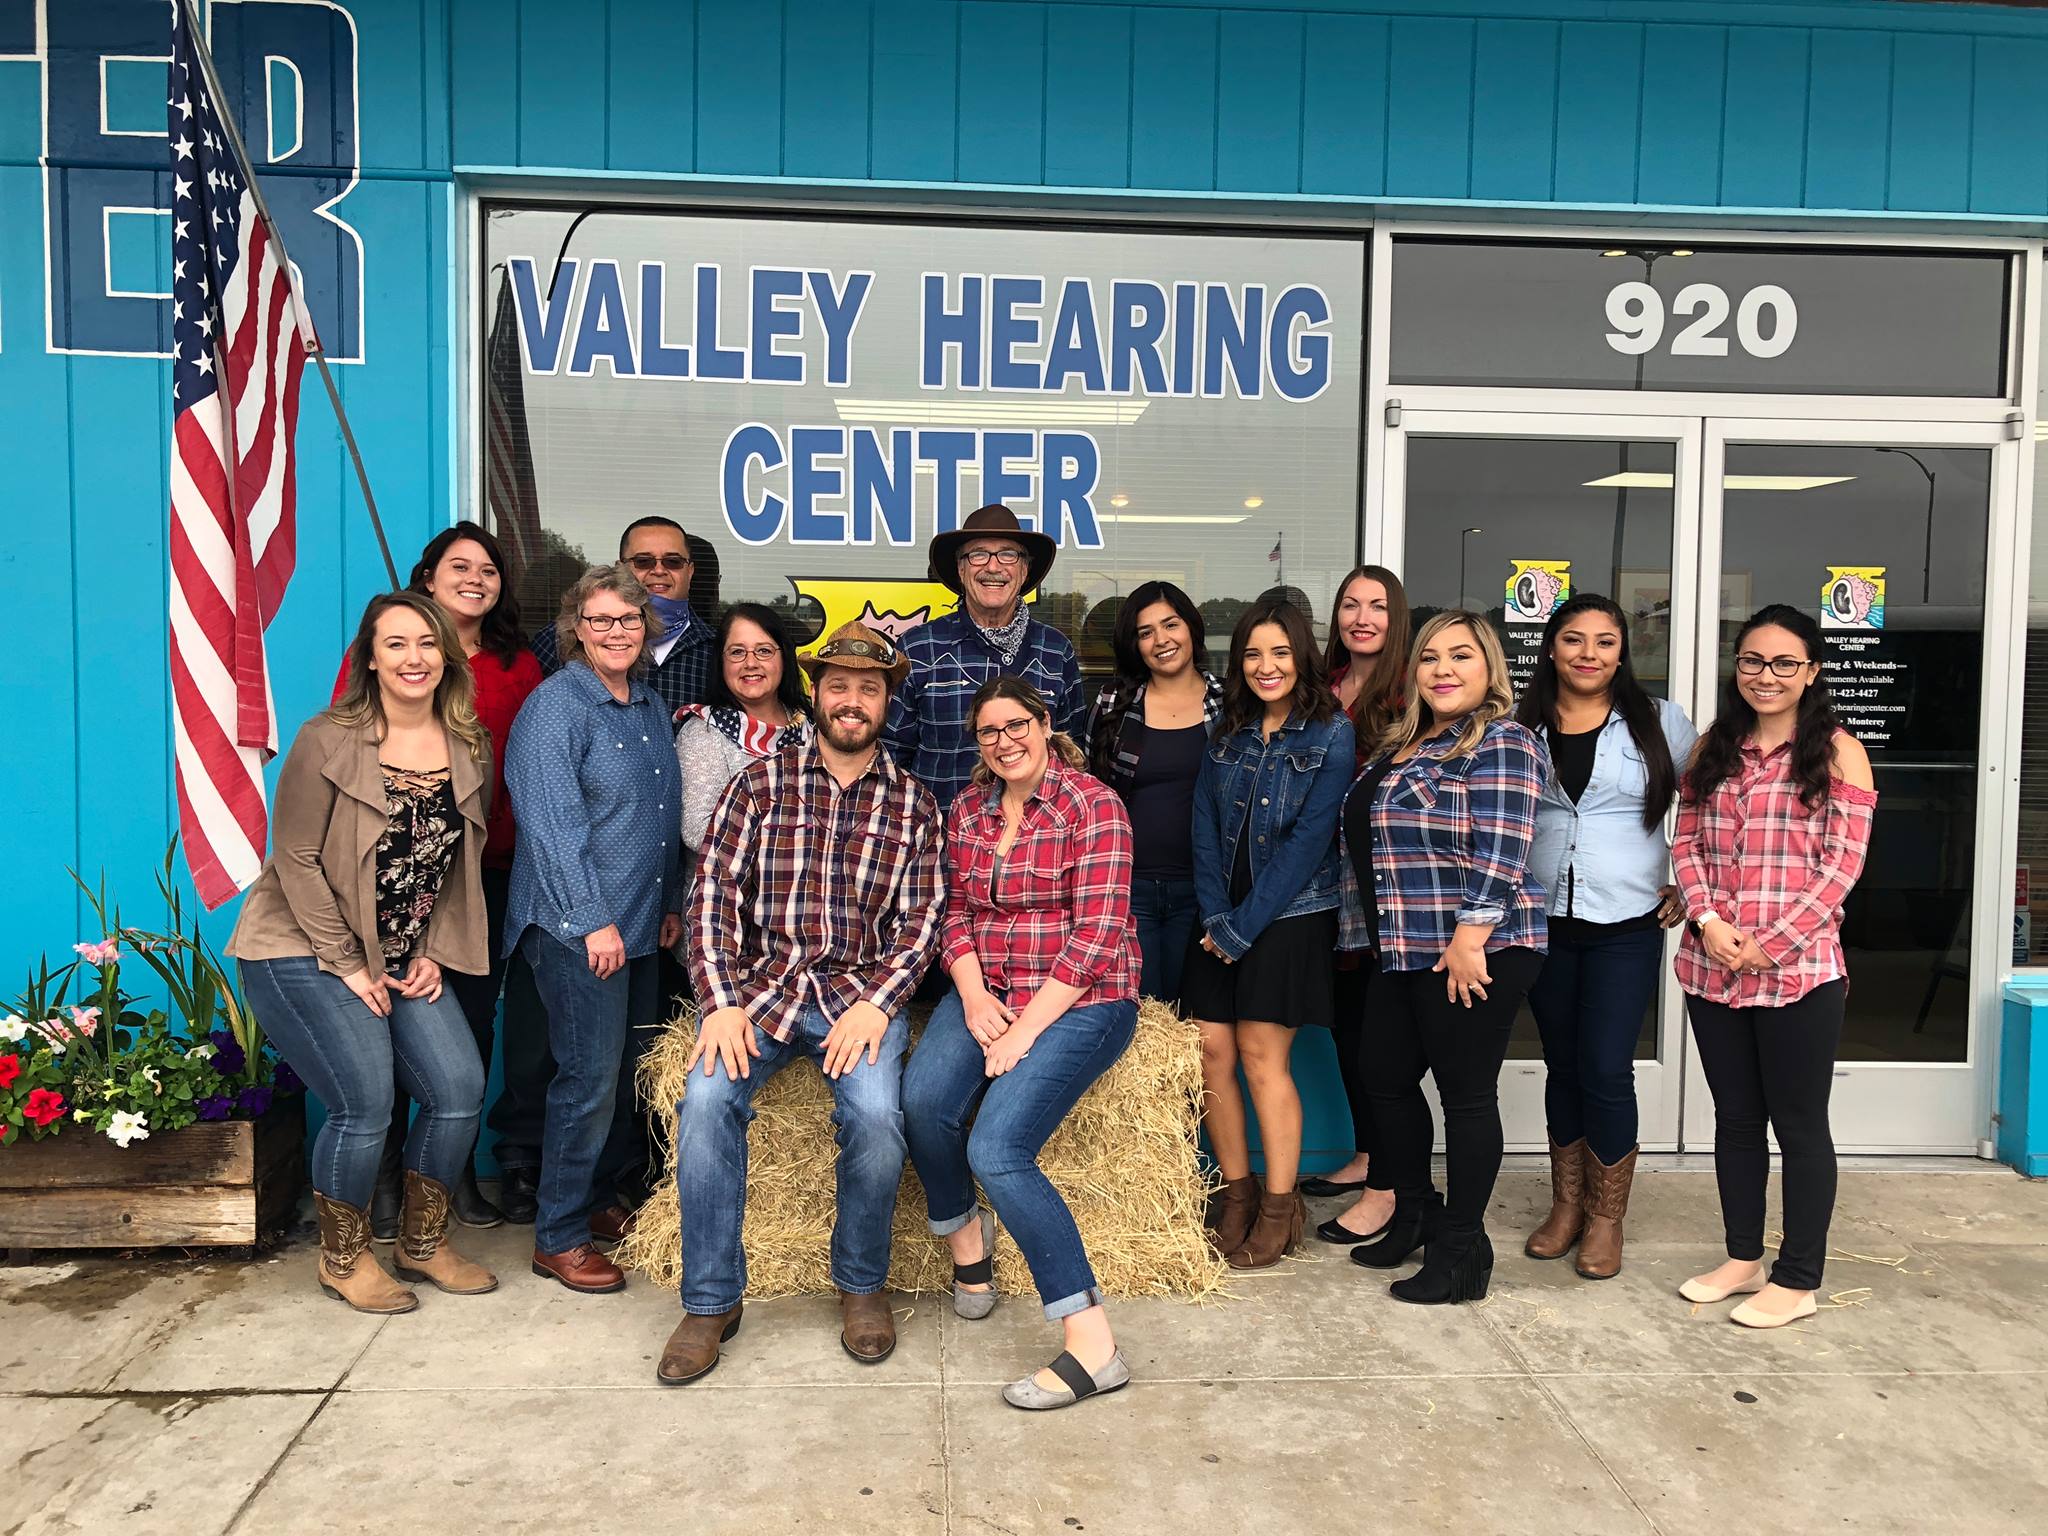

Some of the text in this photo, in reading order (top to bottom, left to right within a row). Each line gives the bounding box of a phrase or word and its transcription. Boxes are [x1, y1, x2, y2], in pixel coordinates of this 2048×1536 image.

[0, 0, 365, 364] ER
[1604, 281, 1798, 359] 920
[506, 255, 1333, 403] VALLEY HEARING
[720, 421, 1104, 550] CENTER
[1824, 636, 1848, 644] VALLEY
[1821, 661, 1897, 670] ning & Weekends
[1827, 689, 1879, 697] 31-422-4427
[1830, 703, 1906, 713] eyhearingcenter.com
[1847, 718, 1886, 727] Monterey
